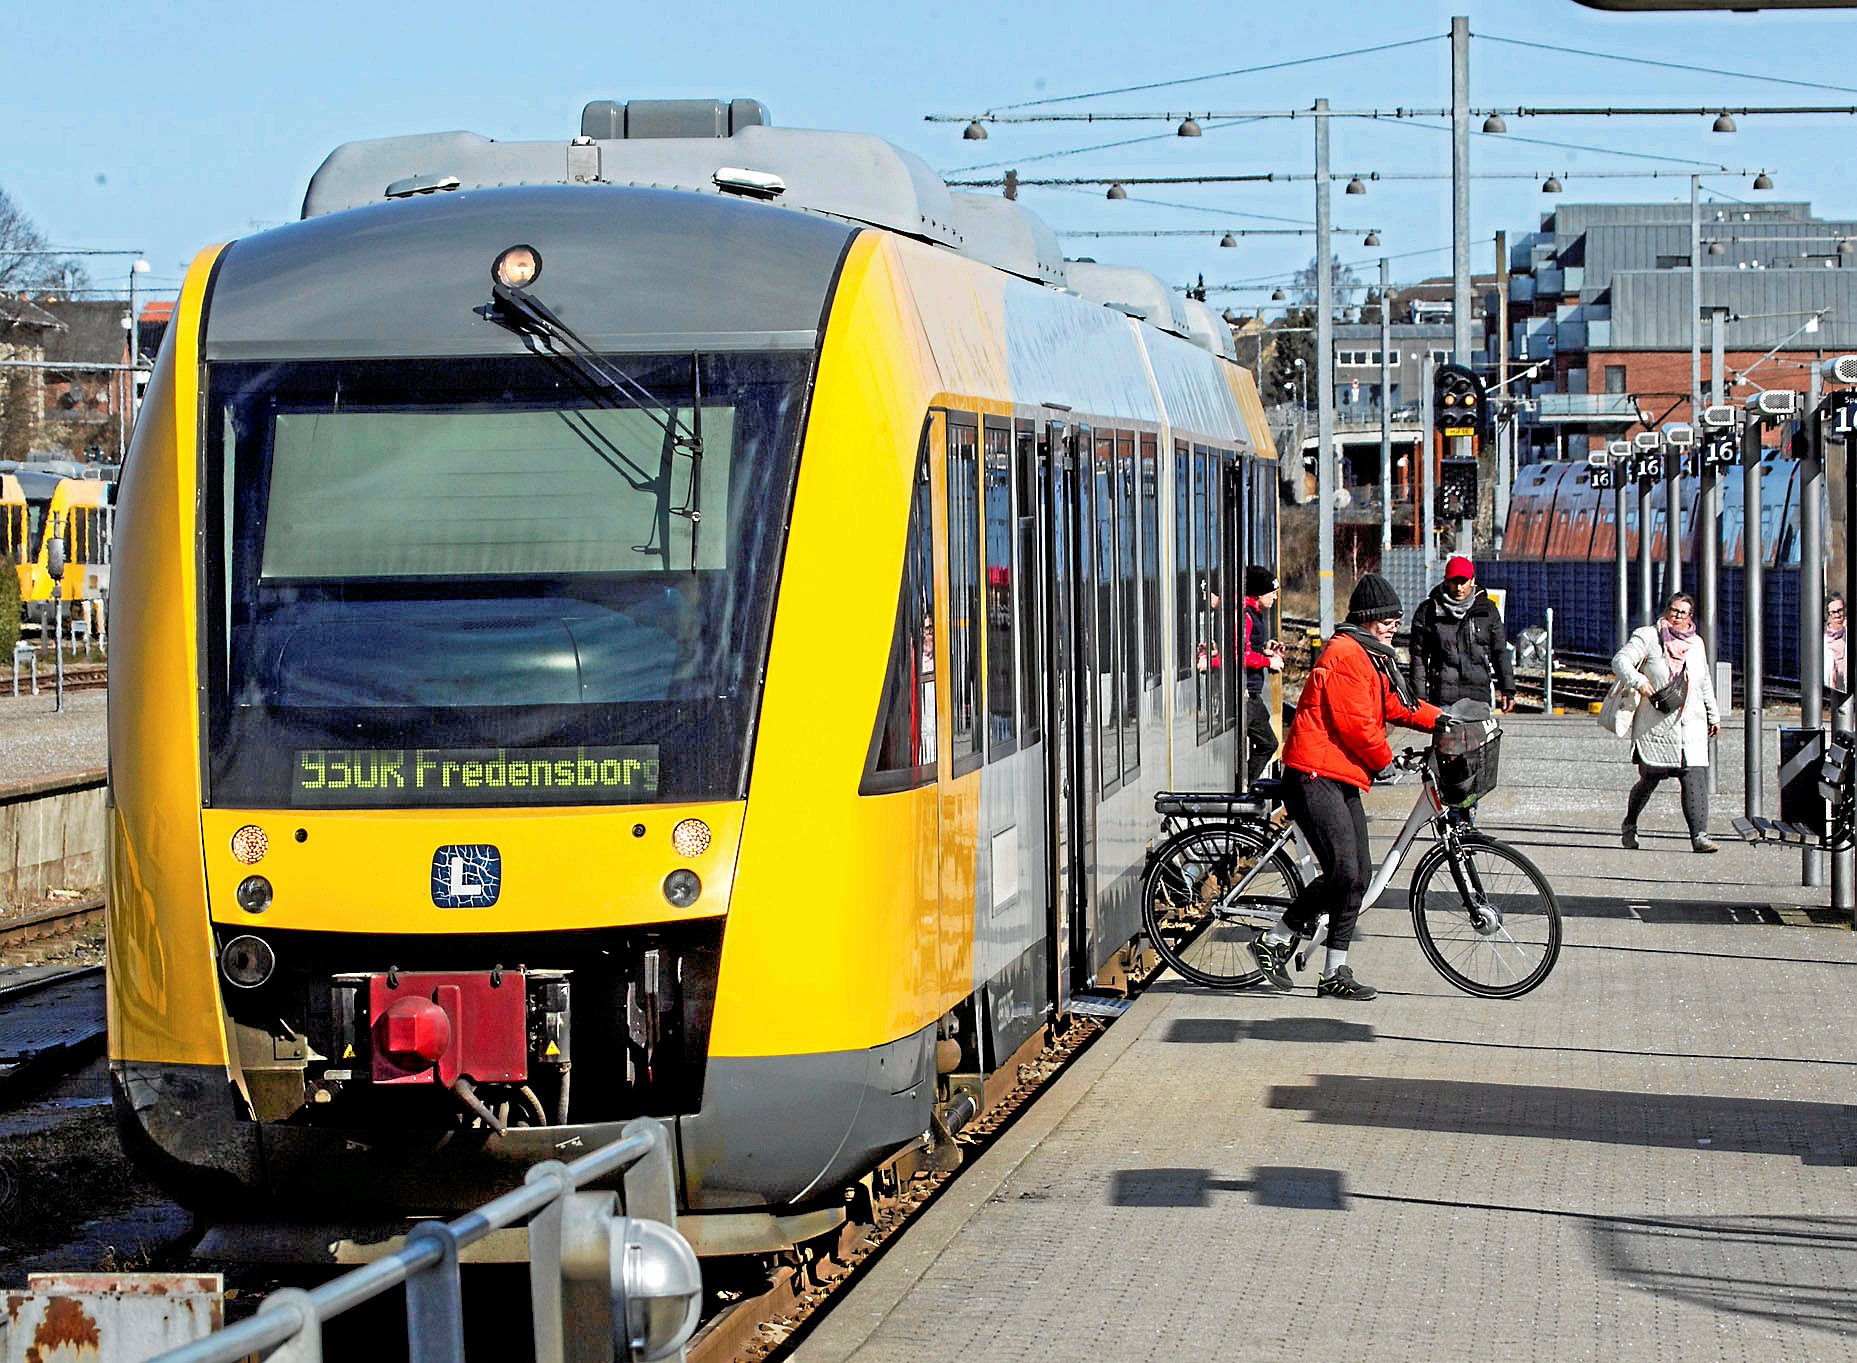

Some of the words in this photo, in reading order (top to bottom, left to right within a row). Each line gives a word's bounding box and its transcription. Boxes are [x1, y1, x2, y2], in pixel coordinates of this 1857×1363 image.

[1706, 441, 1733, 462] 16
[1637, 459, 1659, 476] 16
[1592, 473, 1609, 487] 16
[450, 856, 482, 896] L
